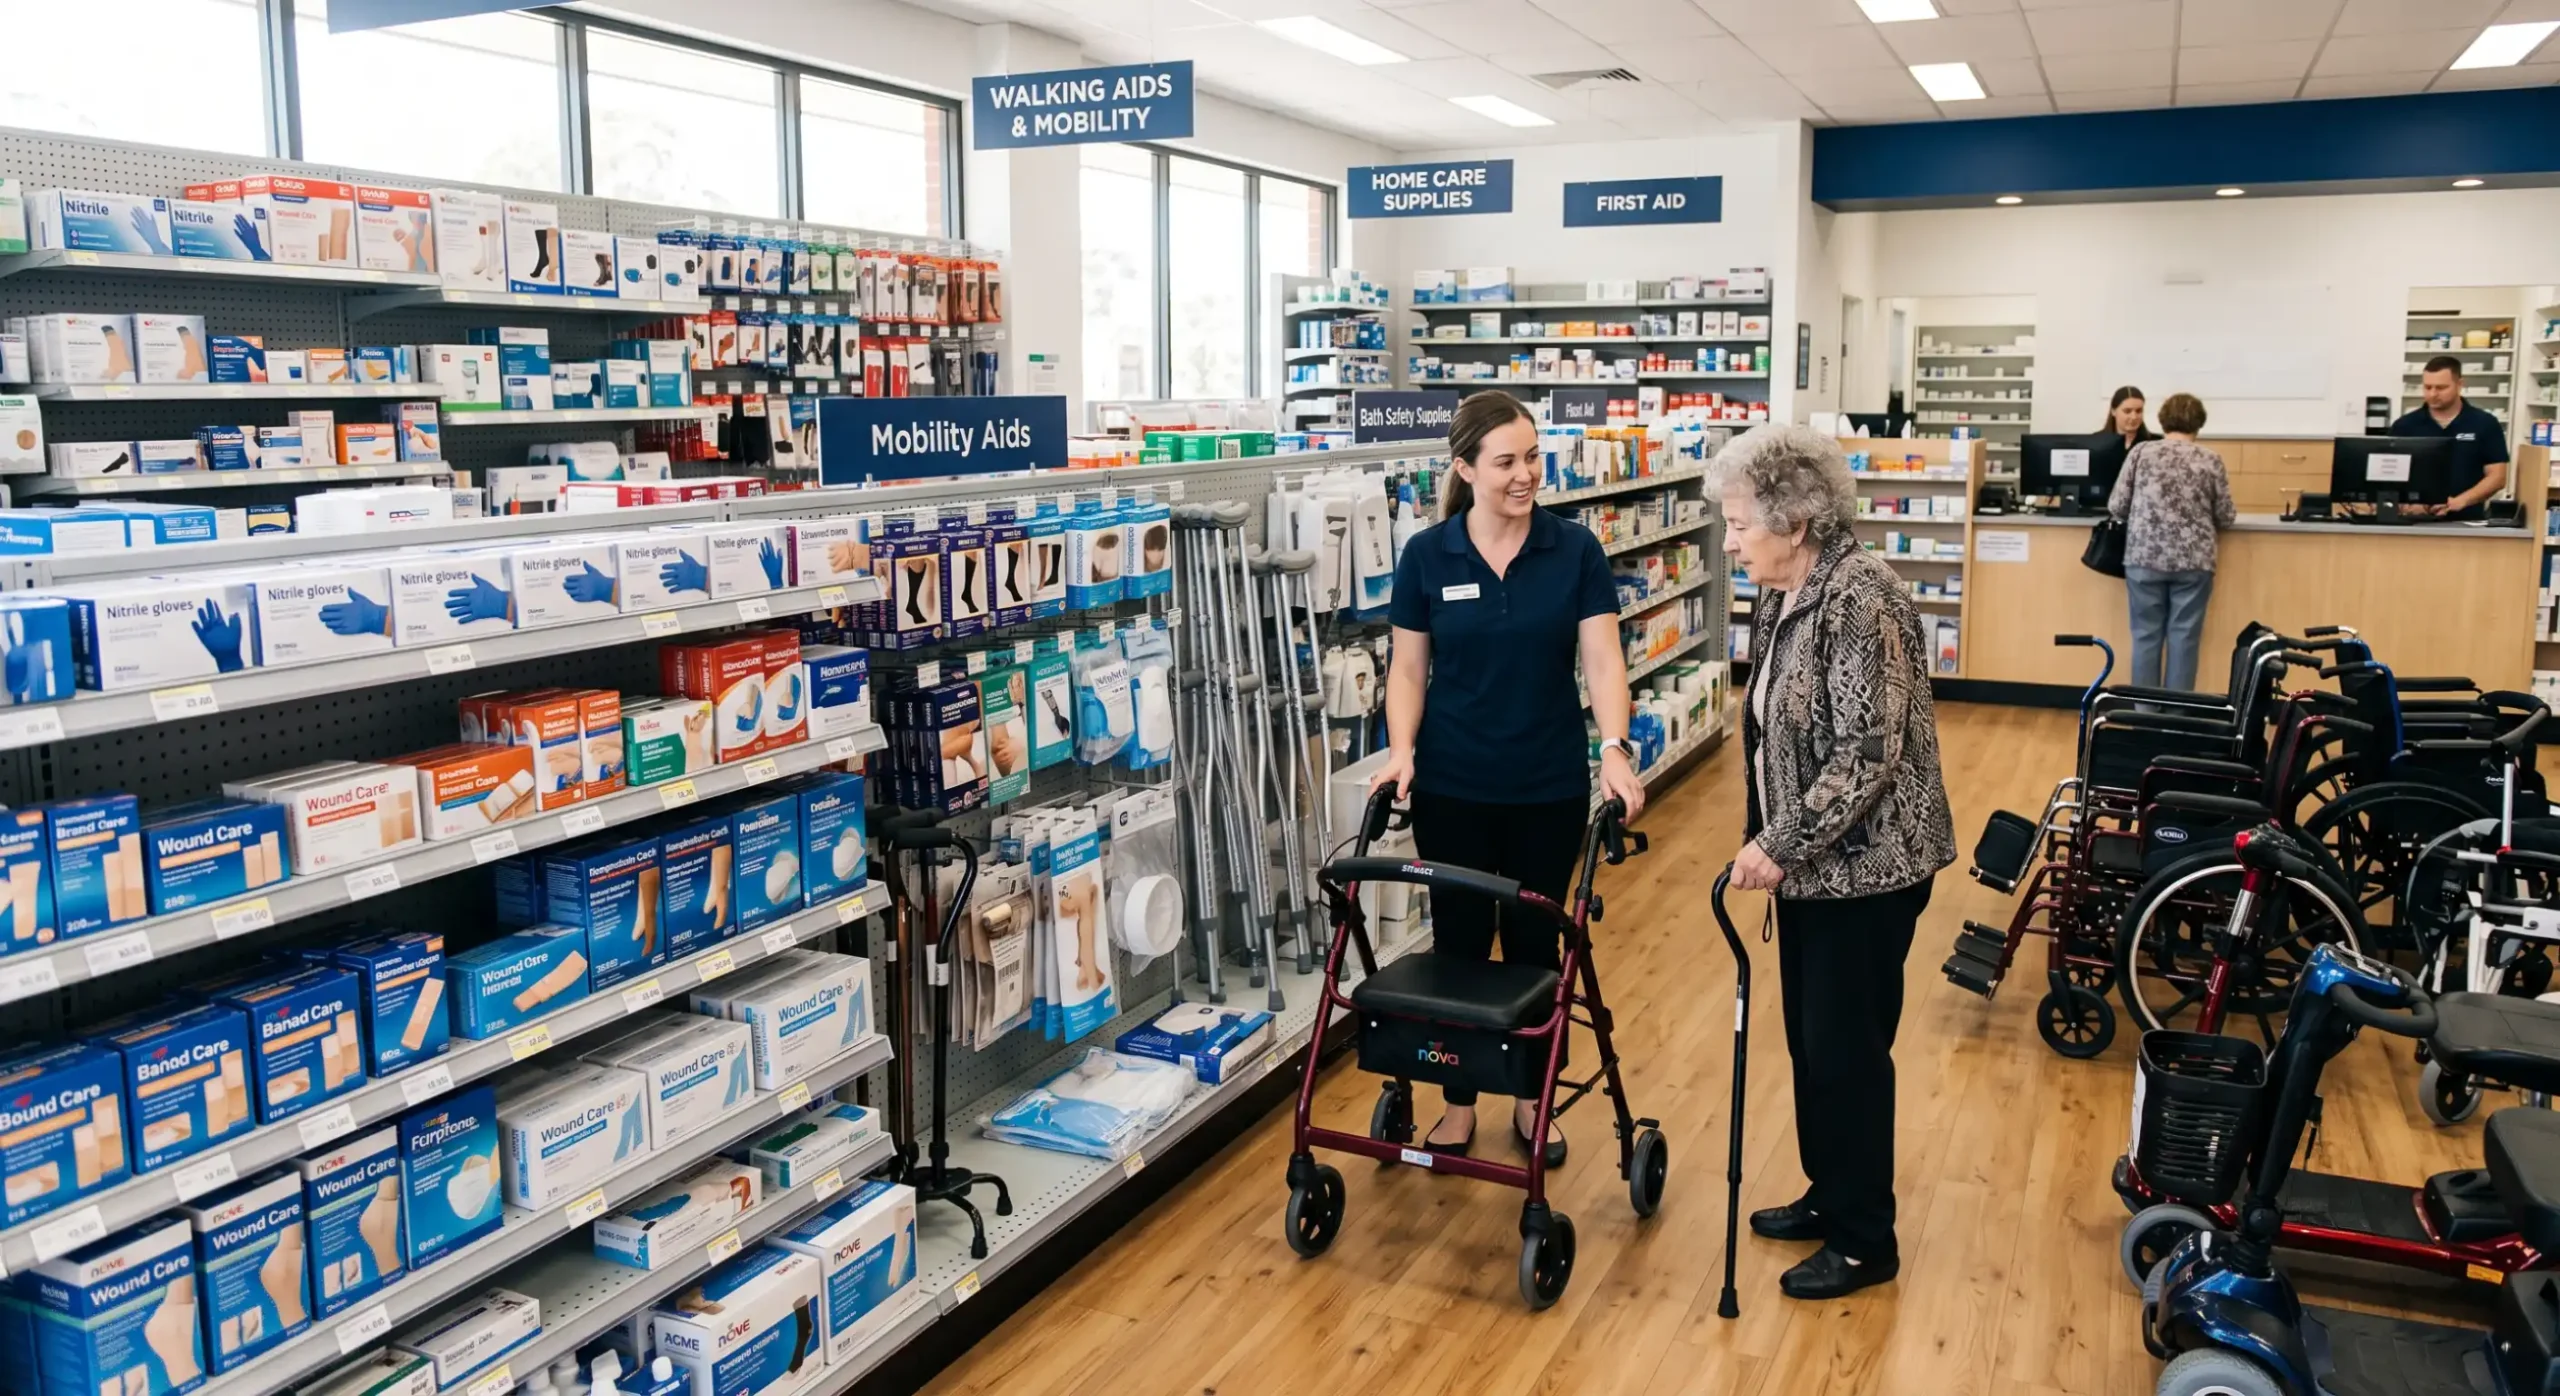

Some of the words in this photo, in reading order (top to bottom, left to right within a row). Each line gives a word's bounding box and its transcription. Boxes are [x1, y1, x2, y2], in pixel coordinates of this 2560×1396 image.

[990, 79, 1105, 109] WALKING
[1112, 73, 1173, 100] AIDS
[1011, 115, 1028, 137] &
[1034, 106, 1151, 136] MOBILITY
[1372, 172, 1428, 190] HOME
[1433, 168, 1487, 187] CARE
[65, 200, 110, 216] Nitrile
[1383, 191, 1473, 211] SUPPLIES
[1596, 195, 1648, 212] FIRST
[1653, 194, 1686, 210] AID
[174, 210, 214, 225] Nitrile
[1360, 407, 1384, 427] Bath
[1416, 405, 1452, 428] Supplies
[871, 422, 974, 457] Mobility
[981, 418, 1032, 449] Aids
[553, 556, 582, 571] gloves
[651, 546, 678, 559] gloves
[400, 572, 433, 586] Nitrile
[435, 570, 469, 584] gloves
[268, 585, 305, 601] Nitrile
[306, 583, 344, 600] gloves
[106, 602, 149, 619] Nitrile
[152, 600, 194, 616] gloves
[305, 789, 353, 812] Wound
[158, 828, 214, 855] Wound
[216, 823, 253, 841] Care
[481, 959, 523, 985] Wound
[310, 1000, 343, 1021] Care
[778, 995, 817, 1022] Wound
[818, 984, 844, 1005] Care
[192, 1039, 230, 1061] Care
[1418, 1048, 1459, 1066] nova
[660, 1059, 699, 1087] Wound
[700, 1049, 726, 1068] Care
[0, 1095, 58, 1131] Bound
[60, 1083, 101, 1108] Care
[541, 1112, 585, 1143] Wound
[587, 1100, 615, 1121] Care
[317, 1166, 366, 1199] Wound
[366, 1156, 397, 1178] Care
[213, 1215, 267, 1250] Wound
[268, 1203, 300, 1226] Care
[90, 1270, 151, 1306] Wound
[153, 1255, 190, 1279] Care
[664, 1332, 700, 1352] ACME
